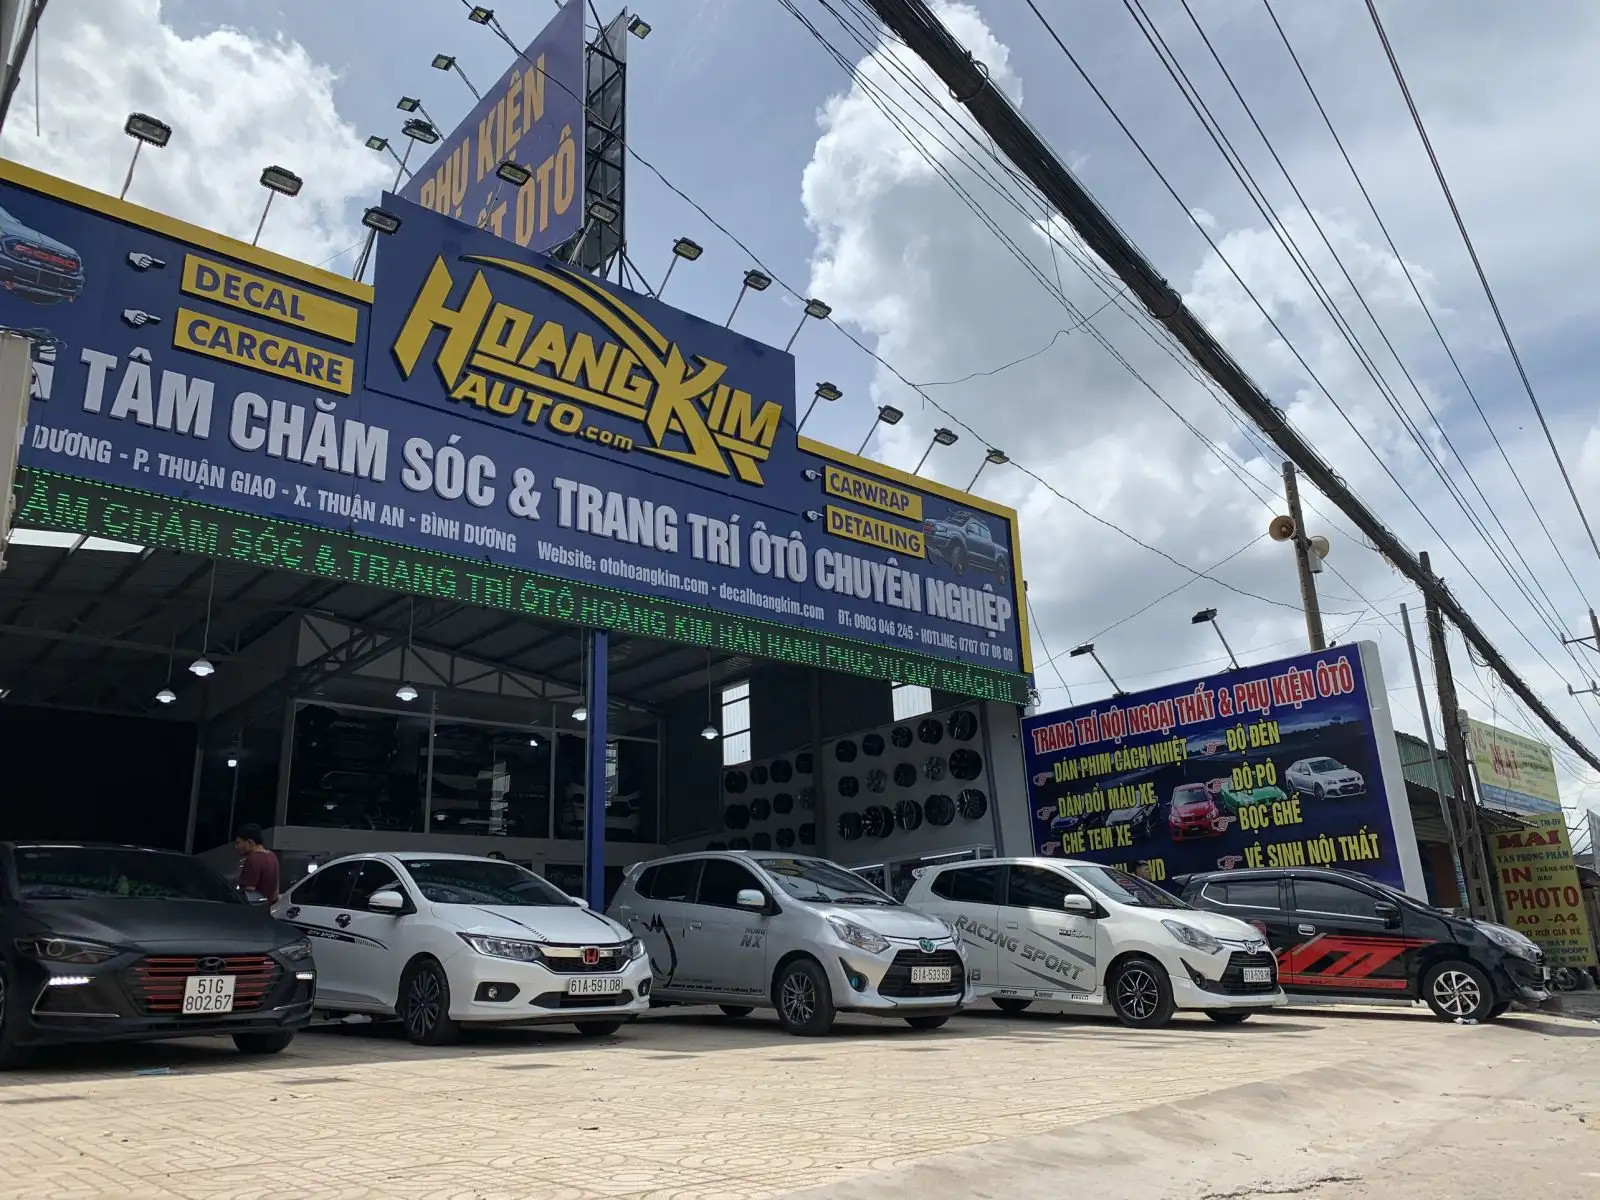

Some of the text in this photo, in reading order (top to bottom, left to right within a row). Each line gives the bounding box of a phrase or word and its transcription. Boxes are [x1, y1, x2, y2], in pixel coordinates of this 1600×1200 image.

[195, 264, 305, 322] DECAL
[188, 319, 344, 385] CARCARE
[80, 346, 215, 440] TÂM
[230, 392, 389, 482] CHĂM
[401, 434, 497, 508] SÓC
[508, 467, 541, 520] &
[553, 477, 678, 553] TRANG
[687, 514, 741, 568] TRÍ
[750, 520, 808, 583] ÔTÔ
[815, 548, 921, 612] CHUYÊN
[925, 578, 1012, 638] NGHIỆP
[830, 472, 910, 512] CARWRAP
[13, 475, 88, 529] ÂM
[347, 550, 457, 597] TRANG
[158, 453, 225, 490] THUẬN
[231, 471, 276, 500] GIAO
[318, 489, 376, 523] THUẬN
[380, 506, 405, 528] AN
[421, 512, 459, 541] BÌNH
[464, 523, 517, 553] DƯƠNG
[538, 540, 596, 571] Website:
[600, 557, 709, 596] otohoangkim.com
[719, 582, 825, 621] decalhoangkim.com
[854, 612, 877, 632] 0903
[832, 512, 920, 553] DETAILING
[1032, 656, 1354, 755] TRANG TRÍ NỘI NGOẠI THẤT & PHỤ KIỆN ÔTÔ
[1225, 719, 1281, 754] ĐỘ ĐÈN
[1054, 735, 1189, 783] DÁN PHIM CÁCH NHIỆT
[1255, 757, 1277, 788] PÔ
[1058, 792, 1083, 818] DÁN
[1107, 782, 1137, 810] MÀU
[1138, 782, 1158, 805] XE
[1238, 792, 1303, 834] BỌC GHẾ
[1063, 823, 1133, 854] CHẾ TEM XE
[1267, 841, 1306, 868] SINH
[1307, 833, 1337, 869] NỘI
[1338, 825, 1380, 862] THẤT
[1496, 830, 1562, 849] MAI
[1501, 866, 1533, 884] IN
[1505, 886, 1580, 911] PHOTO
[955, 914, 1084, 980] RACING SPORT
[185, 994, 233, 1013] 802.67
[198, 978, 224, 994] 51G
[571, 979, 621, 993] 61A-591.08
